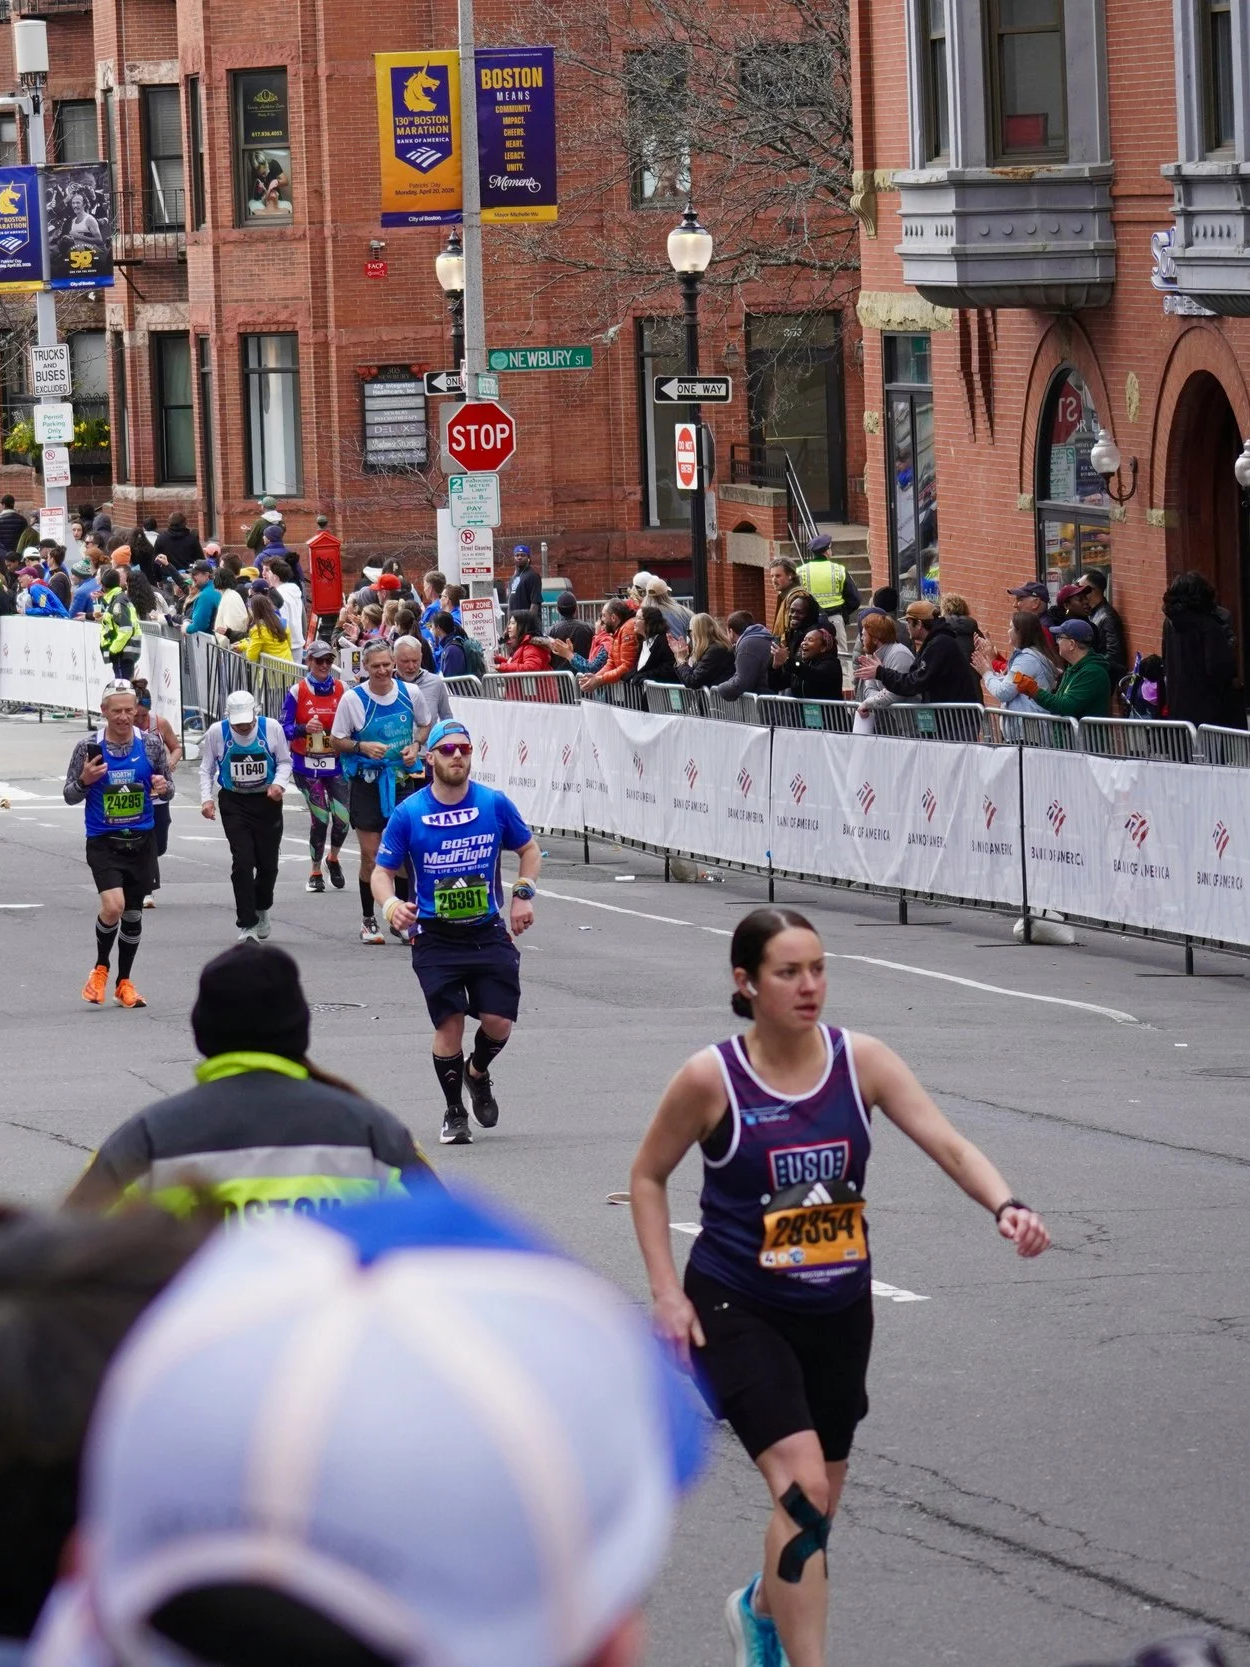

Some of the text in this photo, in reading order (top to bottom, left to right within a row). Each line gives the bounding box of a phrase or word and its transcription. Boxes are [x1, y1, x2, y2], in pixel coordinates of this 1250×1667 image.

[481, 67, 542, 89] BOSTON
[496, 90, 530, 101] MEANS
[495, 104, 532, 113] COMMUNITY.
[414, 115, 449, 125] BOSTON
[503, 116, 526, 125] IMPACT.
[396, 125, 449, 136] MARATHON
[503, 128, 526, 137] CHEERS.
[505, 139, 524, 148] HEART.
[504, 151, 526, 160] LEGACY.
[506, 163, 524, 172] UNITY.
[366, 262, 385, 271] FACP
[34, 348, 65, 361] TRUCKS
[509, 350, 584, 368] NEWBURY ST
[36, 369, 66, 382] BUSES
[36, 384, 68, 394] EXCLUDED
[677, 384, 723, 394] ONE WAY
[42, 420, 66, 429] Parking
[451, 423, 510, 452] STOP
[678, 440, 693, 450] DO NOT
[451, 478, 462, 489] 2
[312, 759, 327, 768] Jo
[111, 771, 133, 779] NORTH
[233, 762, 265, 777] 11640
[107, 793, 142, 810] 24295
[428, 810, 474, 826] MATT
[796, 817, 819, 831] AMERICA
[864, 827, 891, 841] AMERICA
[441, 833, 495, 851] BOSTON
[423, 845, 494, 865] MedFlight
[439, 888, 483, 912] 26391
[787, 1149, 835, 1184] USO
